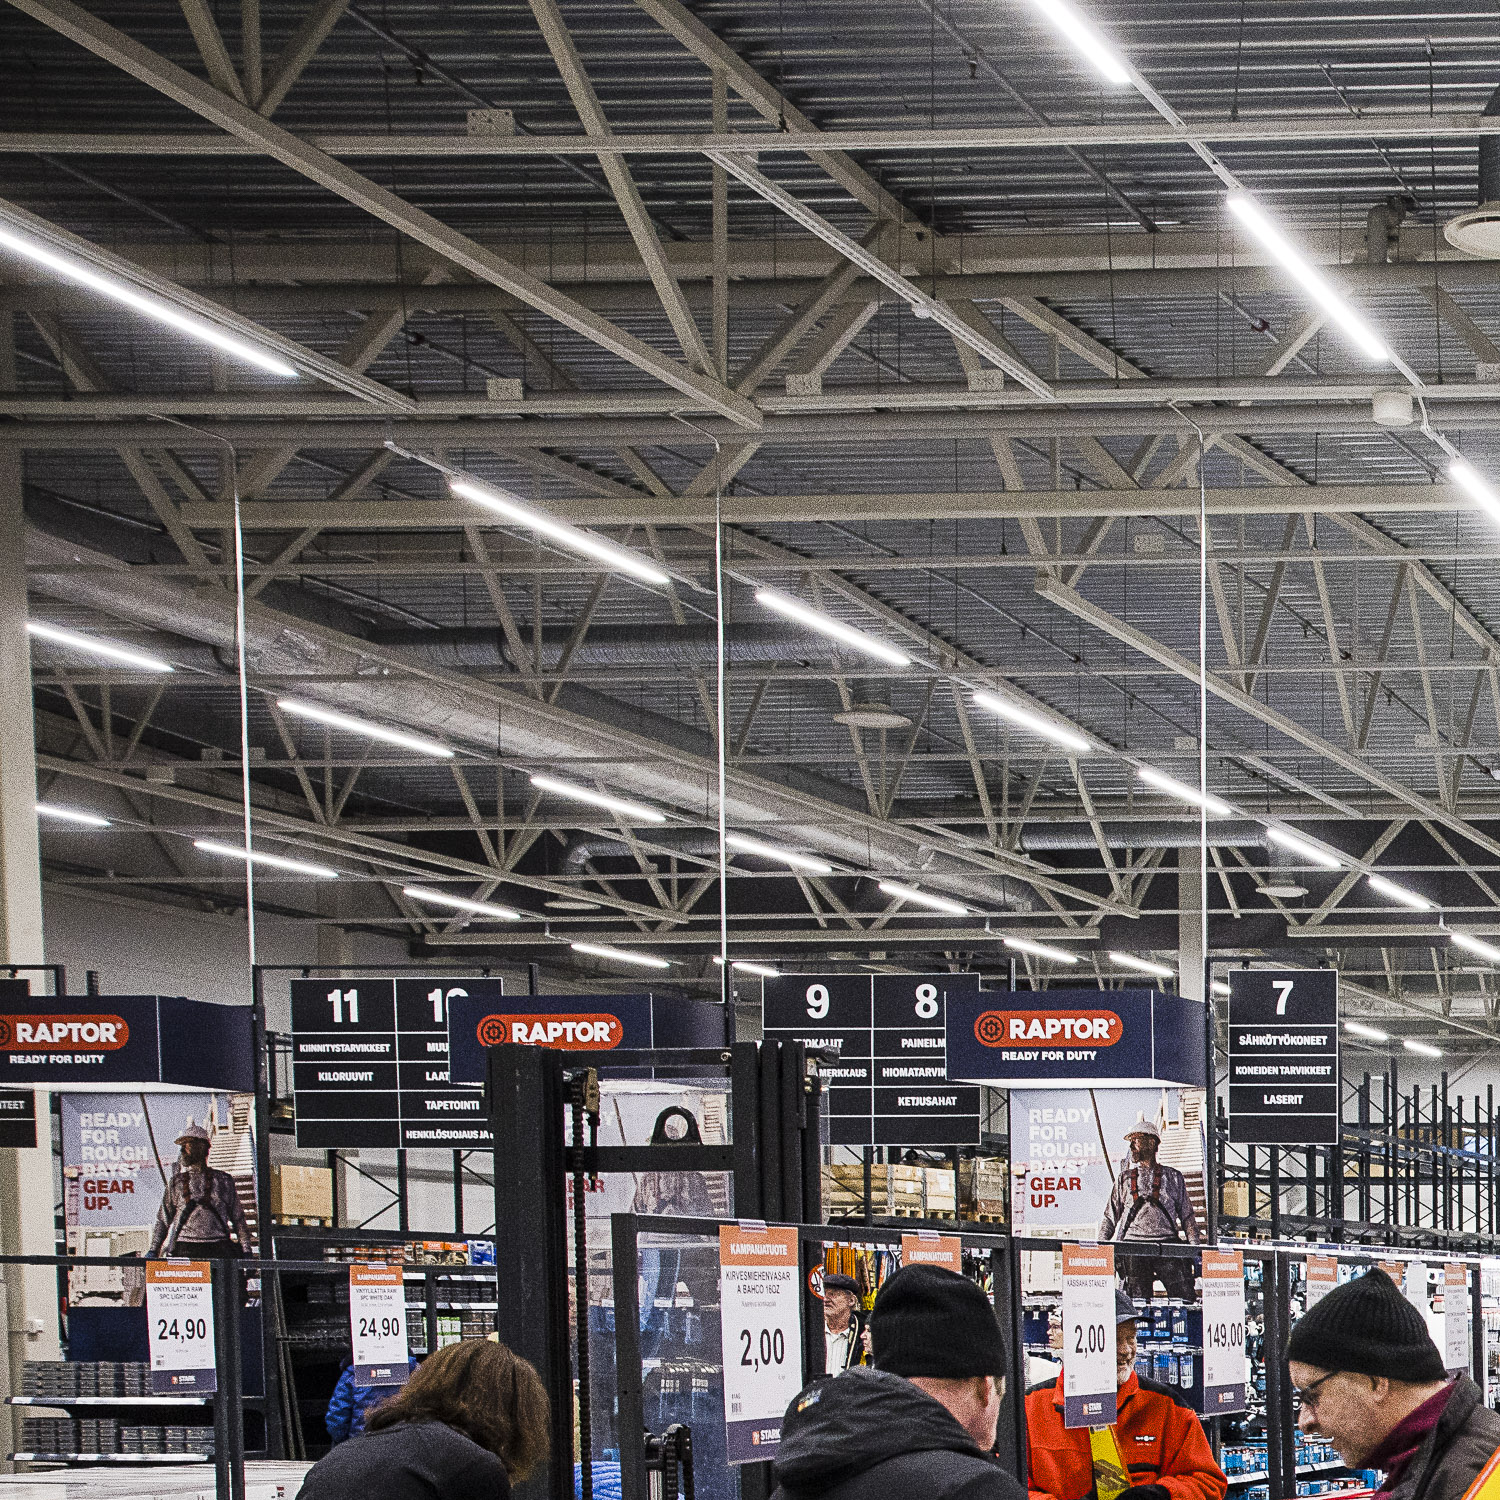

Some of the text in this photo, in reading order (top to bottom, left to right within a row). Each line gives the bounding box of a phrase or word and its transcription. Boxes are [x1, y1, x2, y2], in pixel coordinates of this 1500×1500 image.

[327, 988, 359, 1023] 11
[806, 983, 830, 1020] 9
[914, 983, 939, 1019] 8
[1272, 980, 1294, 1016] 7
[1238, 1034, 1328, 1046] SÄHKÖTYÖKONEET
[9, 1054, 105, 1064] READY FOR DUTY
[1001, 1051, 1097, 1061] READY FOR DUTY
[317, 1071, 374, 1082] KILORUUVIT
[1235, 1065, 1332, 1075] KONEIDEN TARVIKKEET
[424, 1100, 480, 1111] TAPETOINTI
[897, 1096, 958, 1107] KETJUSAHAT
[1263, 1094, 1304, 1105] LASERIT
[79, 1112, 144, 1129] READY
[1029, 1108, 1092, 1124] READY
[80, 1129, 120, 1145] FOR
[1029, 1125, 1068, 1141] FOR
[80, 1146, 149, 1162] ROUGH
[1029, 1142, 1098, 1158] ROUGH
[83, 1179, 135, 1194] GEAR
[1030, 1177, 1082, 1191] GEAR
[84, 1196, 113, 1211] UP.
[1030, 1194, 1059, 1208] UP.
[729, 1243, 788, 1257] KAMPANJATUOTE
[909, 1250, 954, 1263] KAMPANJATUOTE
[157, 1317, 207, 1344] 24,90
[359, 1316, 400, 1341] 24,90
[1207, 1321, 1243, 1352] 149,00
[1074, 1323, 1106, 1359] 2,00
[739, 1327, 785, 1373] 2,00
